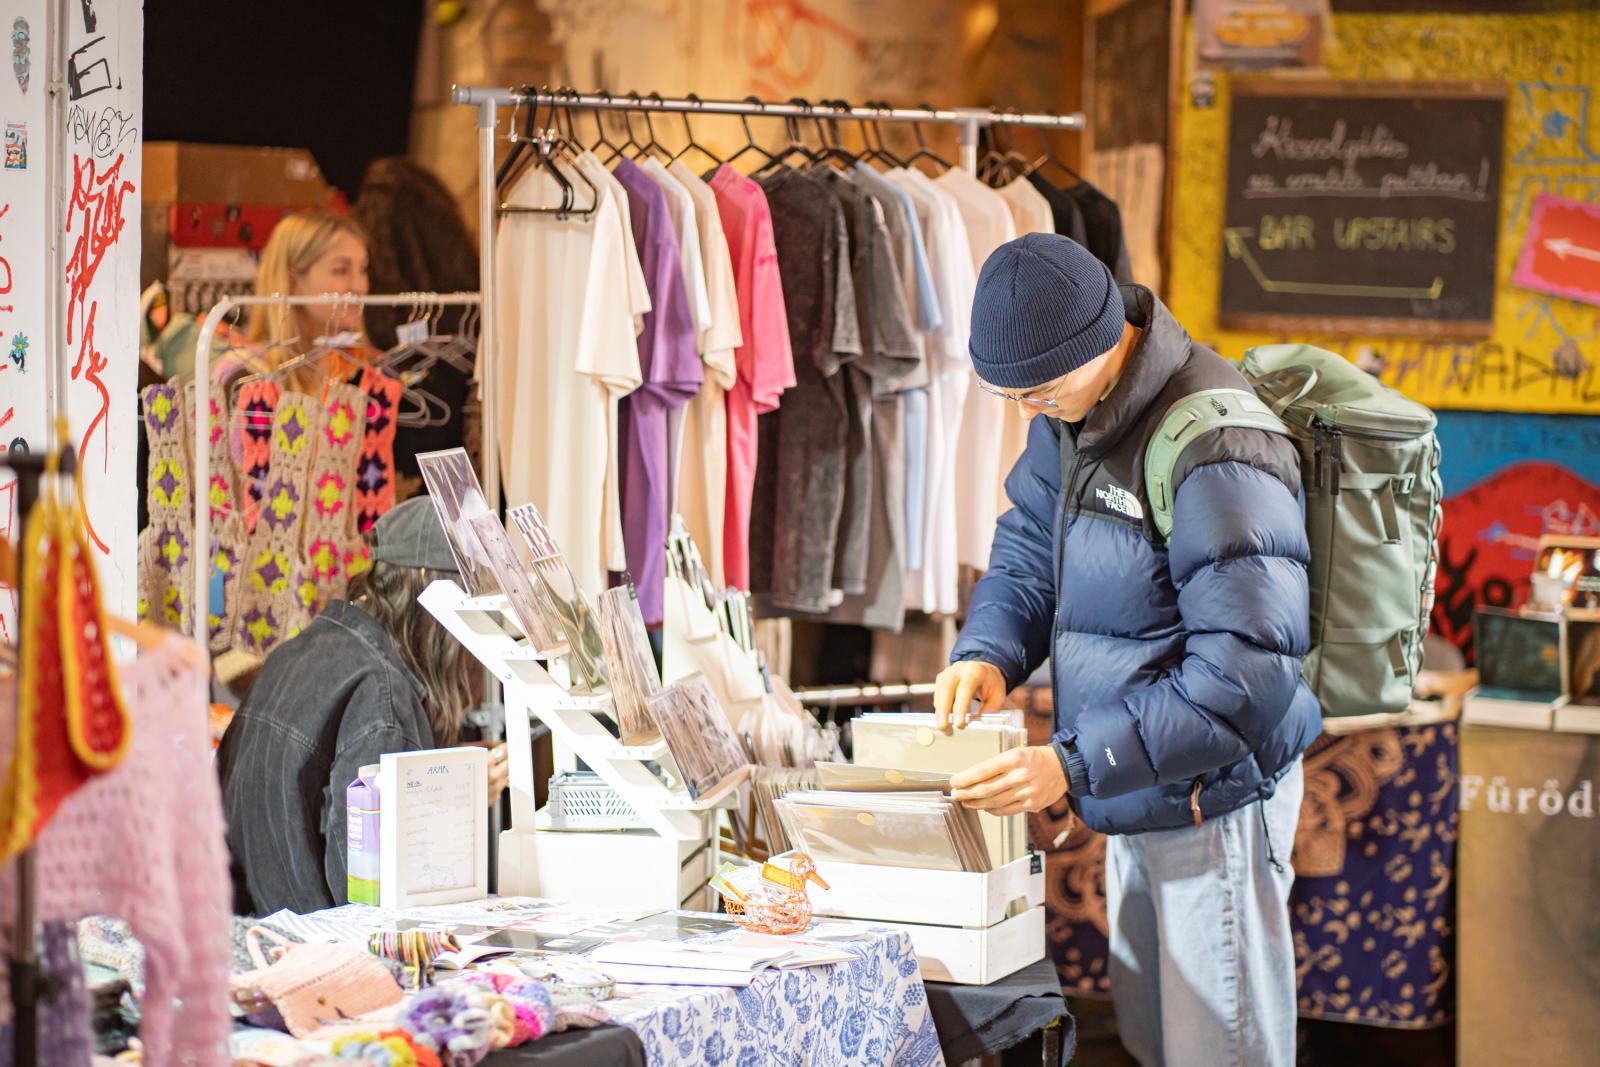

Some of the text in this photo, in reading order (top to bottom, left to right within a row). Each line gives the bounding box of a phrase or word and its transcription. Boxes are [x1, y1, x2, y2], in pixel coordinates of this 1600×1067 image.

[1259, 214, 1457, 254] BAR UPSTAIRS
[1095, 487, 1126, 506] NORTH
[1107, 484, 1125, 498] THE
[1105, 499, 1127, 513] FACE
[1459, 775, 1600, 818] Füröd
